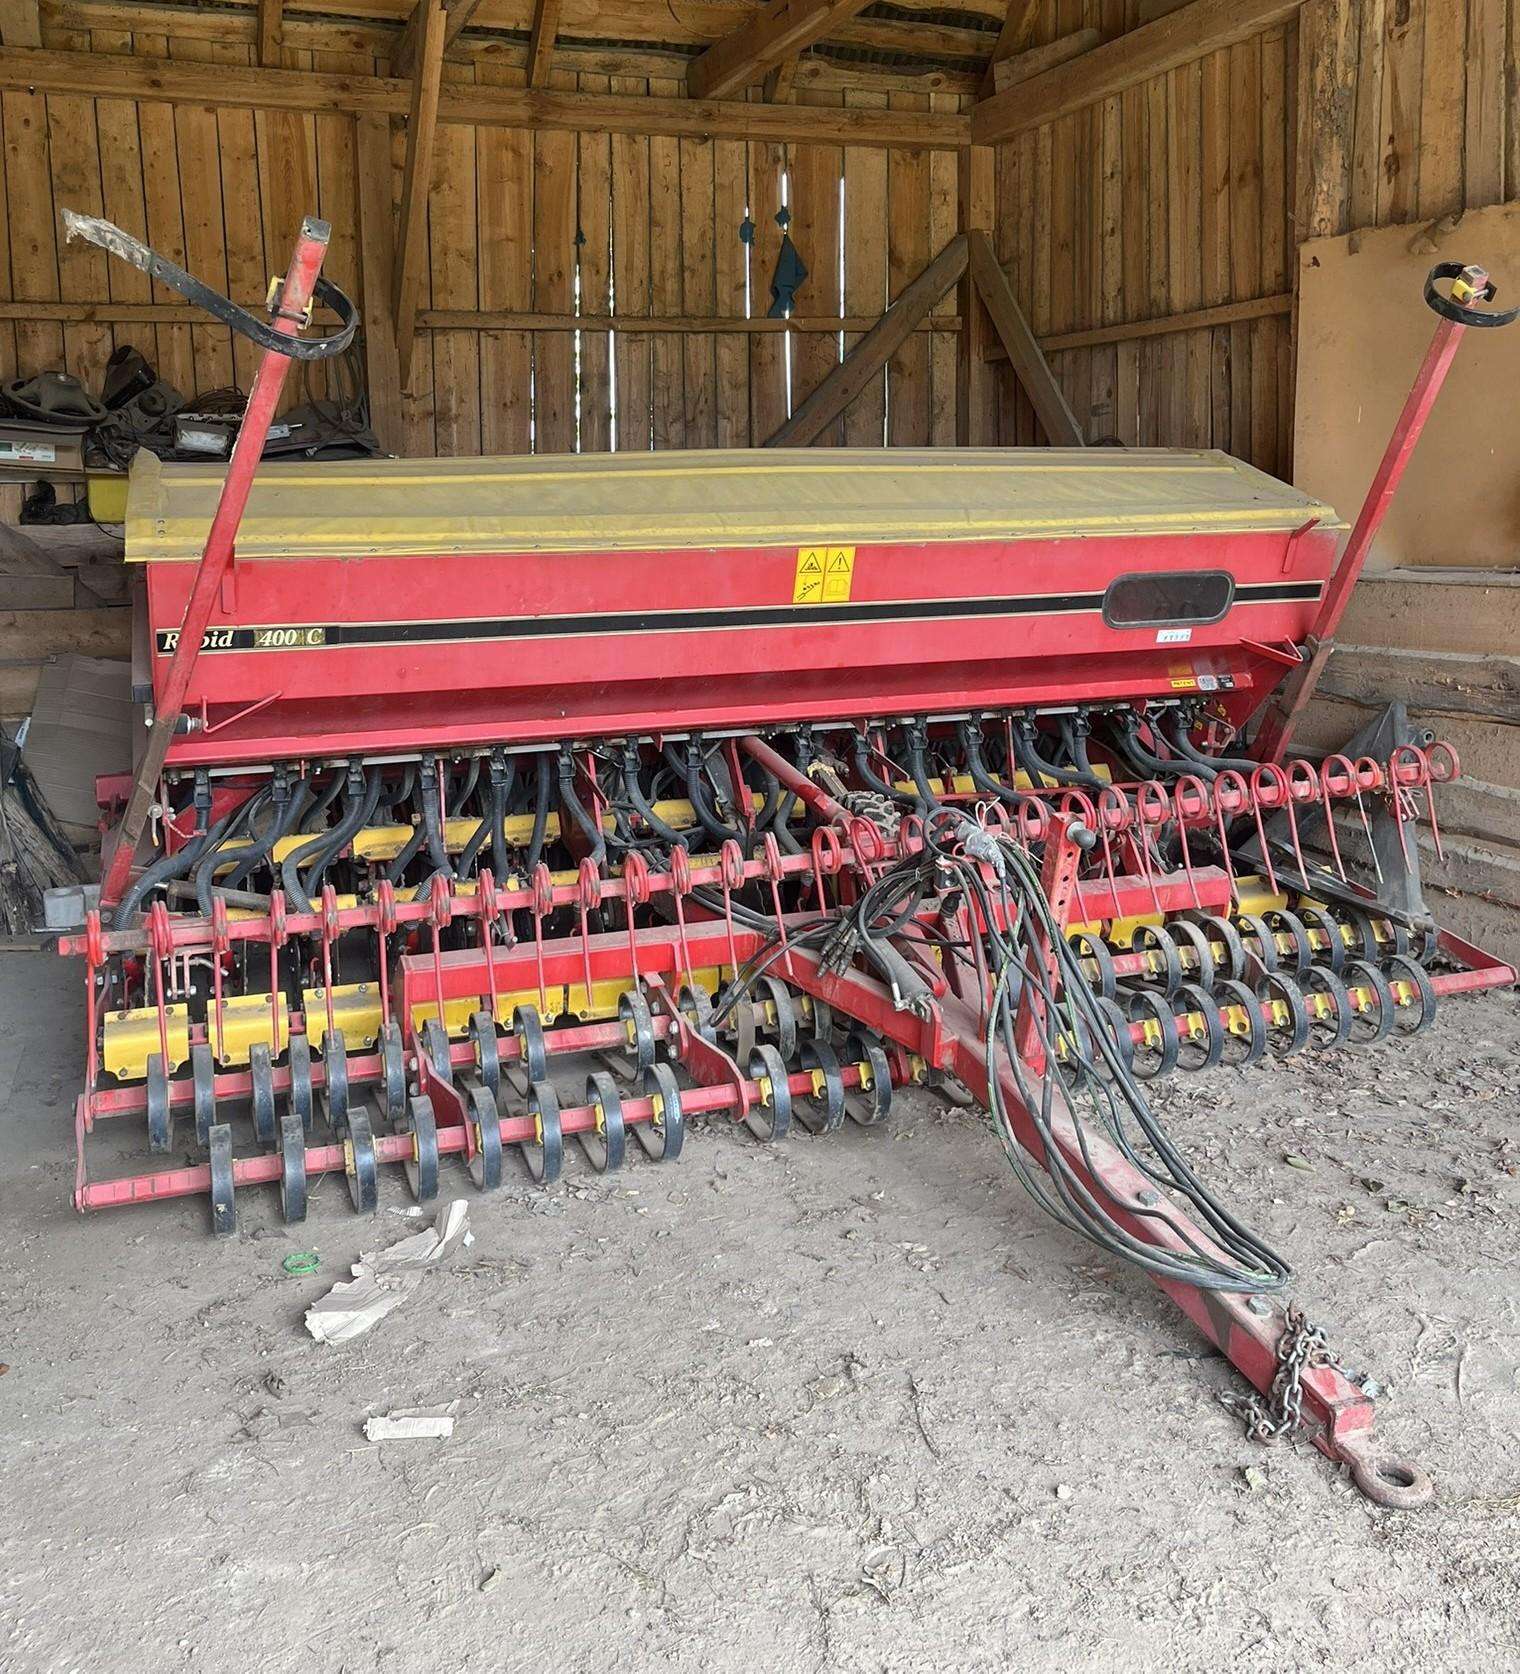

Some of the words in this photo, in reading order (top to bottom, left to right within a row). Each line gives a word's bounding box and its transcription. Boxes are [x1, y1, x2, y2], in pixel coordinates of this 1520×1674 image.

[162, 630, 234, 649] Rid
[258, 629, 297, 646] 400
[307, 628, 323, 645] C
